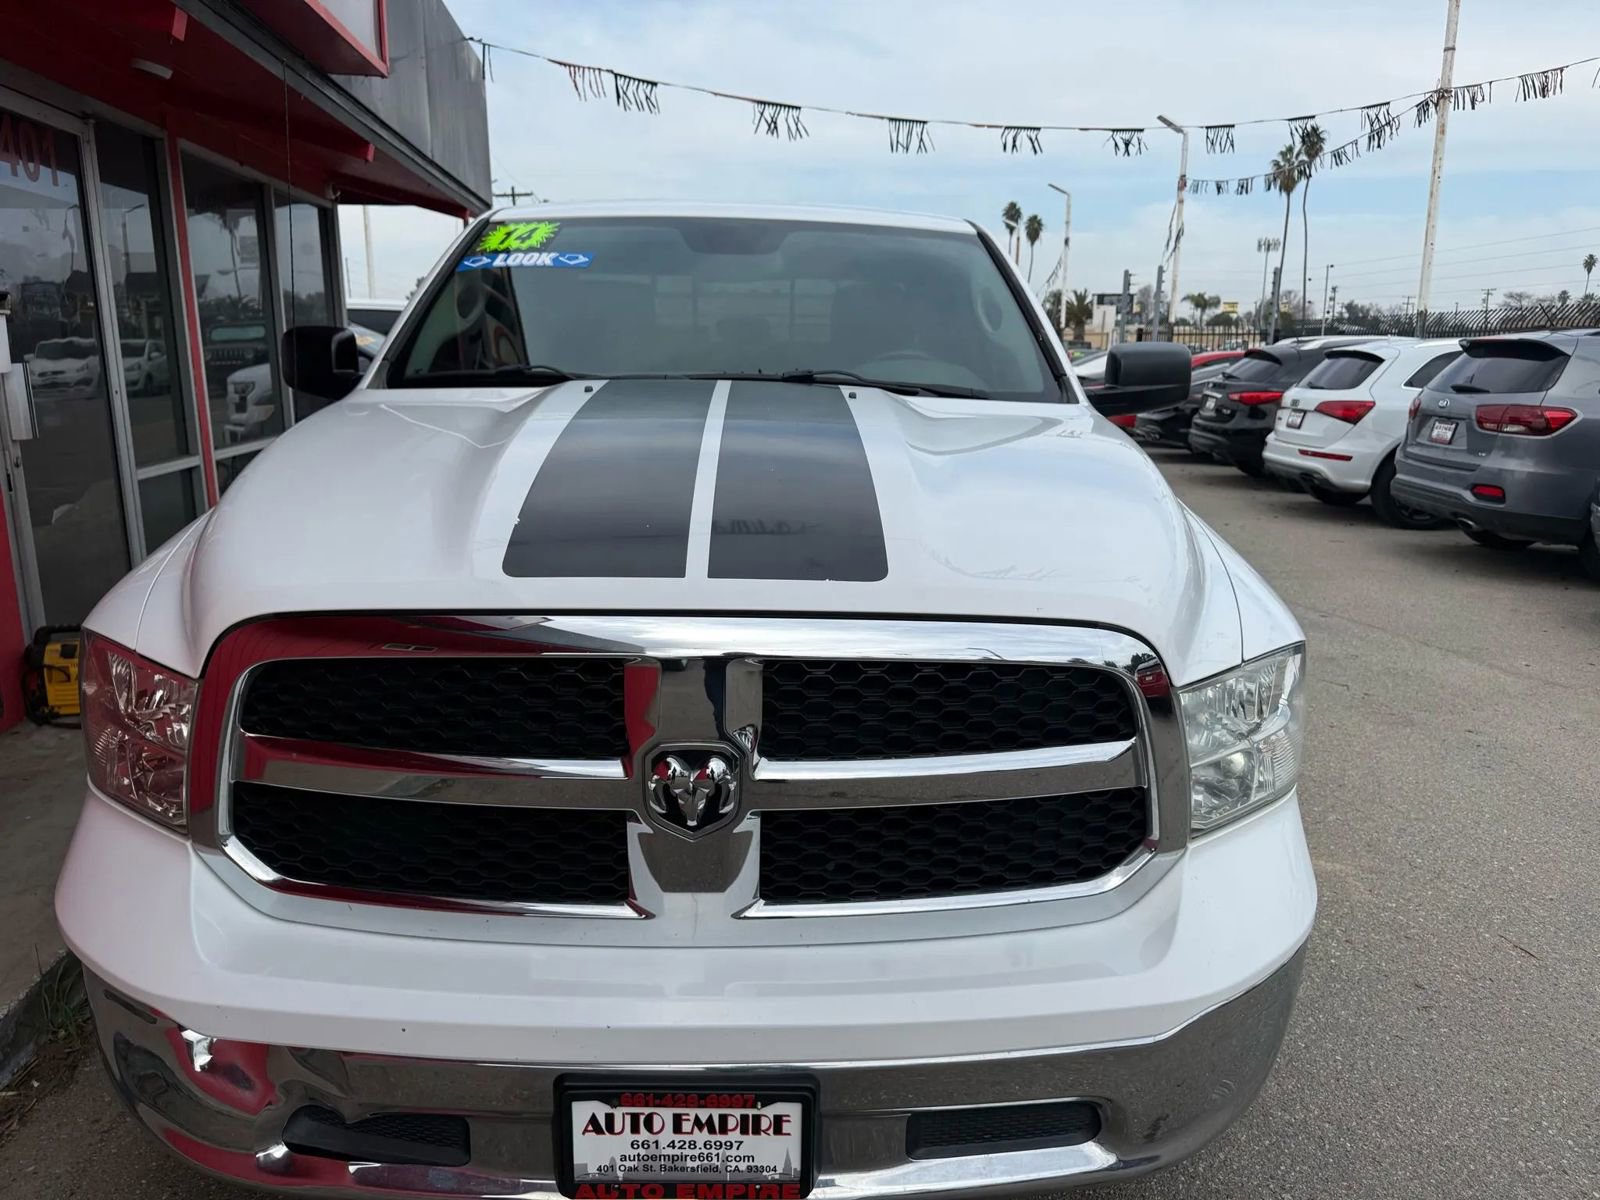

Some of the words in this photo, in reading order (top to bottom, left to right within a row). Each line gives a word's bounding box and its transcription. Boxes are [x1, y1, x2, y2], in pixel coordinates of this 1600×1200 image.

[0, 112, 59, 187] 401
[492, 252, 560, 266] LOOK
[582, 1112, 665, 1136] AUTO
[672, 1113, 792, 1136] EMPIRE
[630, 1139, 744, 1151] 661.428.6997
[619, 1152, 755, 1164] autoempire661.com
[596, 1164, 614, 1173] 401
[618, 1164, 639, 1173] Oak
[642, 1164, 657, 1173] St.
[660, 1164, 722, 1174] Bakersfield,
[725, 1165, 743, 1173] CA.
[746, 1165, 777, 1173] 93304
[575, 1184, 665, 1199] AUTO
[676, 1184, 801, 1199] EMPIRE
